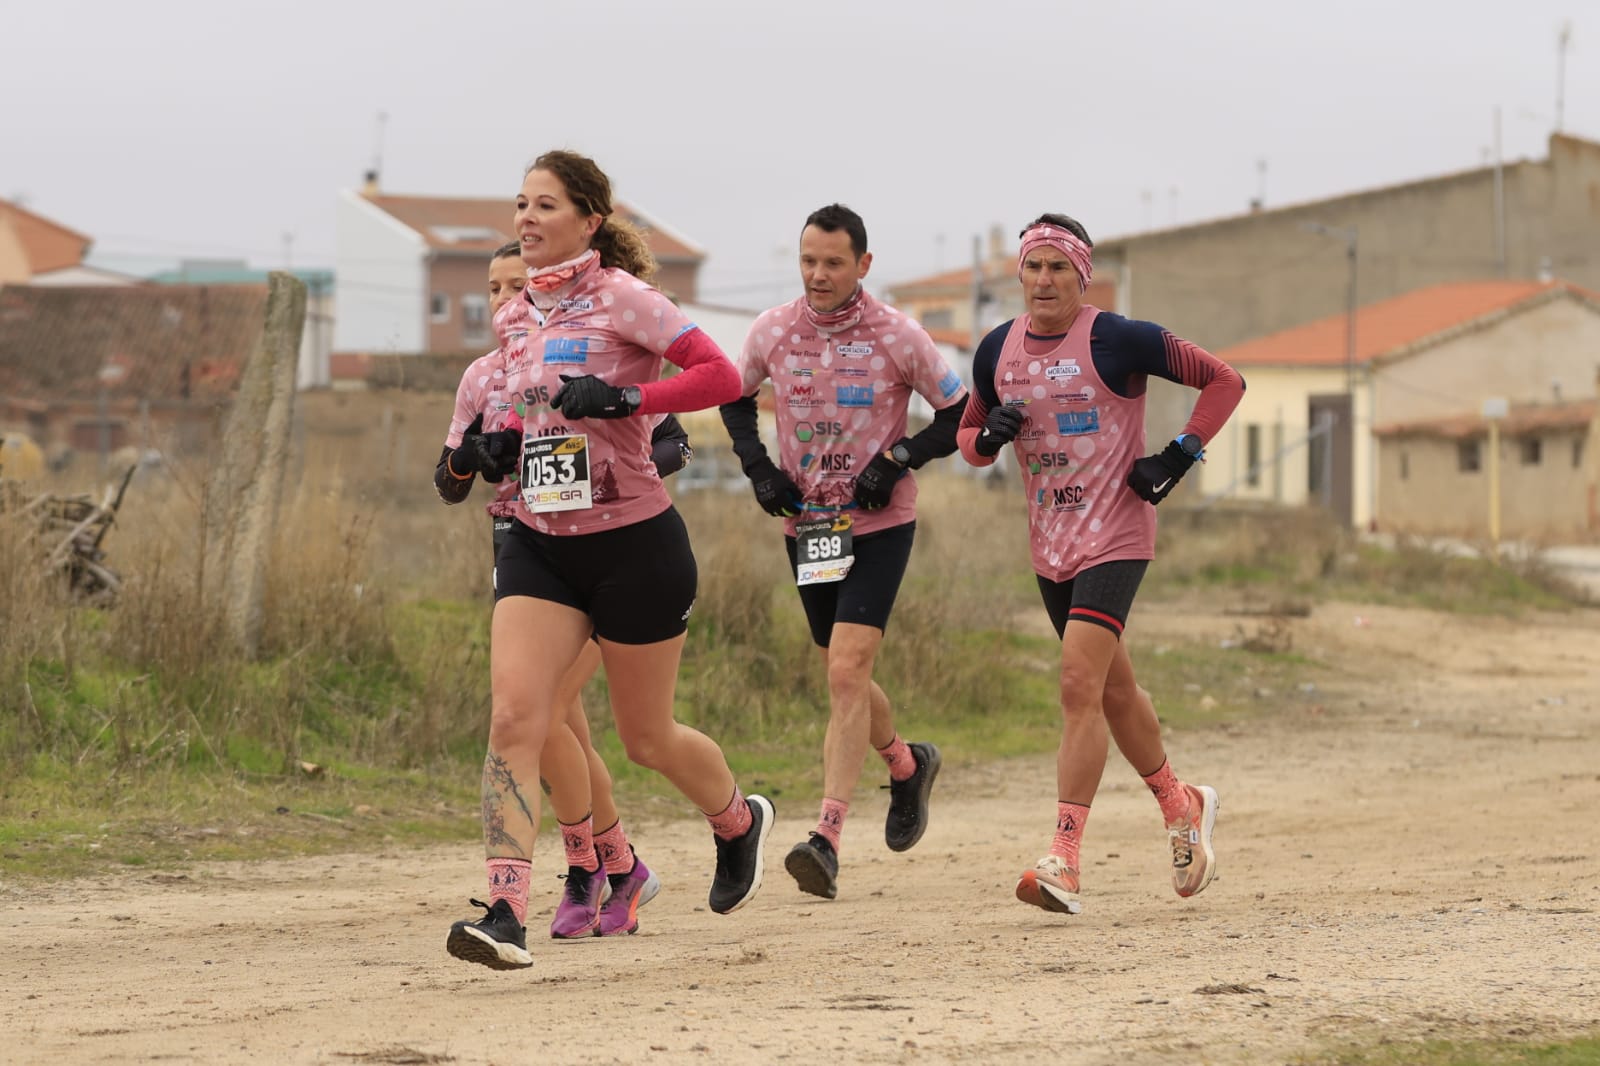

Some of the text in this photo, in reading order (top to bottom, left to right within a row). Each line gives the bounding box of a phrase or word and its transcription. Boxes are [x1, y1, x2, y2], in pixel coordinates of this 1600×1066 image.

[1047, 366, 1078, 376] MORTADELA
[524, 385, 550, 406] SIS
[815, 421, 842, 436] SIS
[821, 453, 852, 471] MSC
[1041, 452, 1069, 467] SIS
[527, 454, 576, 488] 1053
[1053, 485, 1083, 506] MSC
[807, 535, 842, 560] 599
